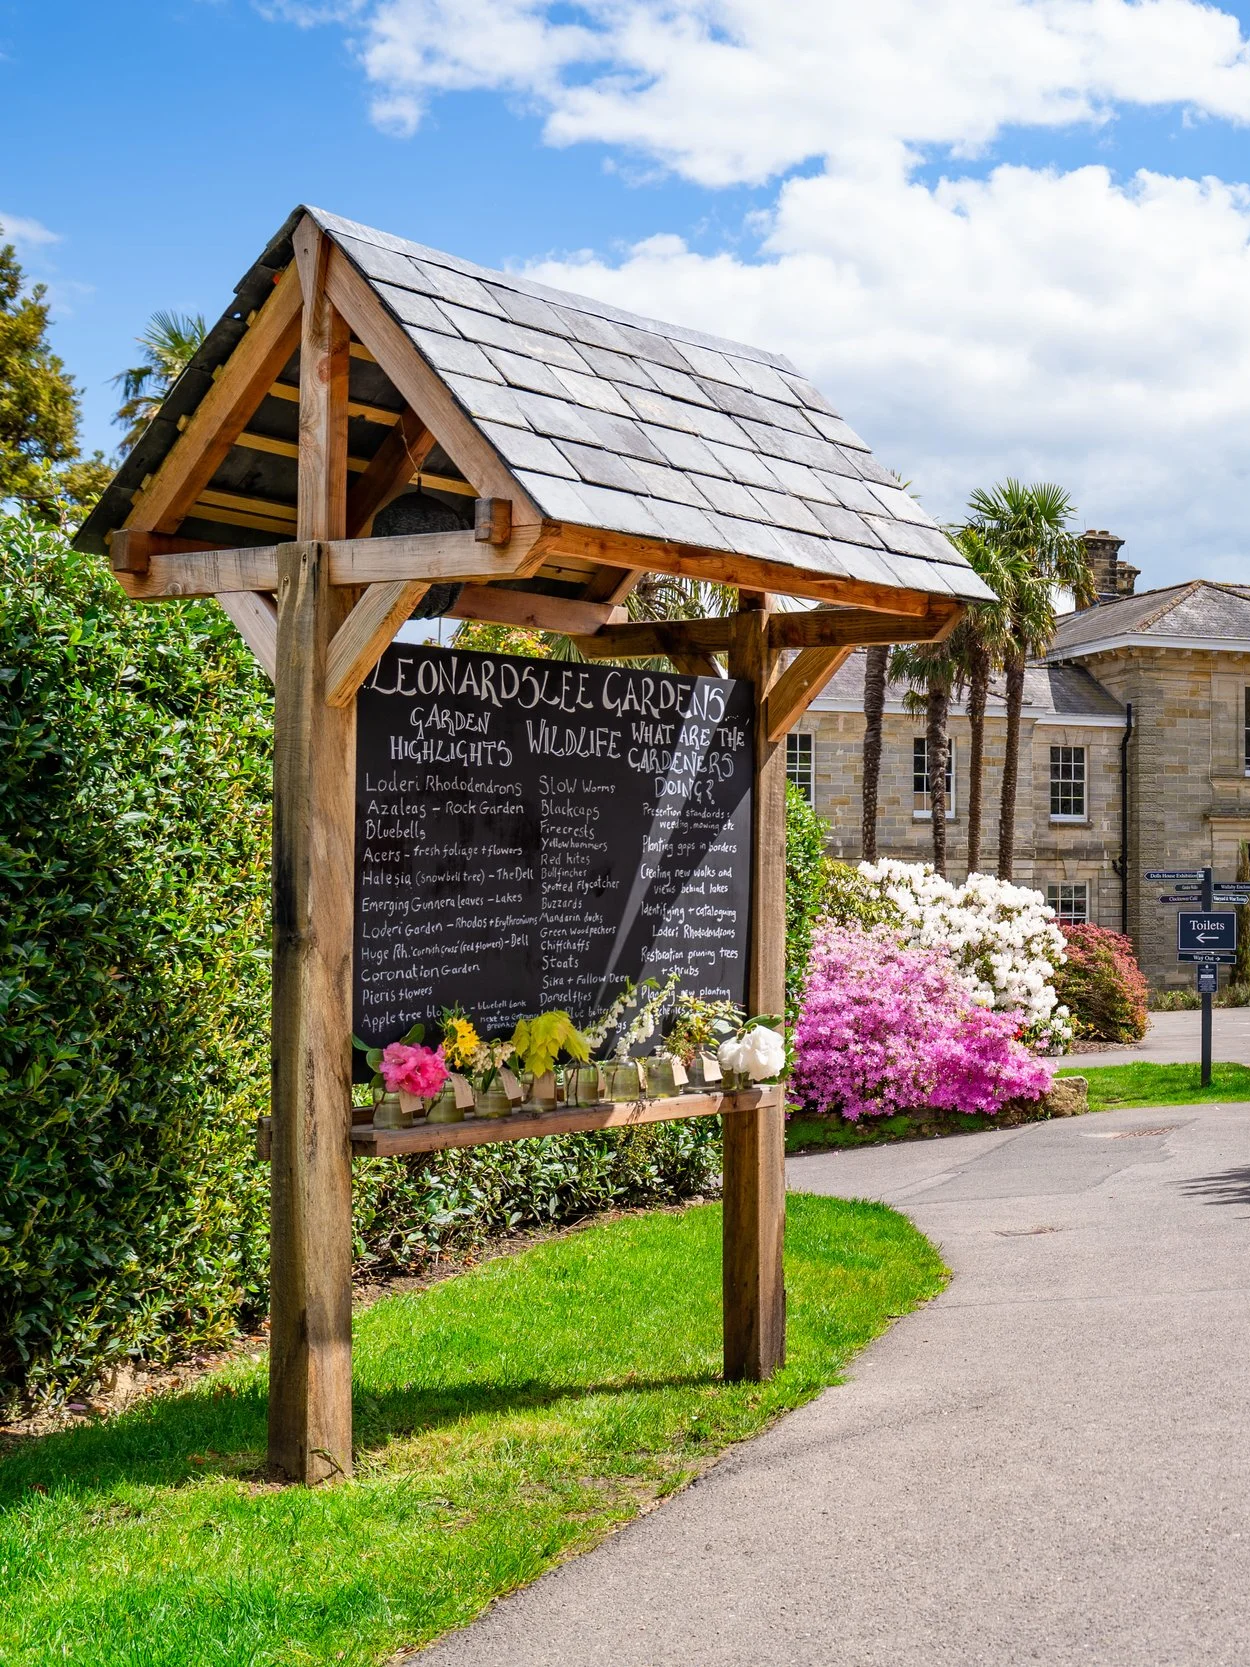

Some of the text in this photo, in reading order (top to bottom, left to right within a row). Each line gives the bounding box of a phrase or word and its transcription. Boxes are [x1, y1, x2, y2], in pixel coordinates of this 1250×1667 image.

[371, 655, 725, 723] LEONARDSLEE GARDENS
[410, 703, 491, 740] GARDEN
[526, 718, 622, 759] WILDLIFE
[631, 720, 745, 751] WHAT ARE THE
[390, 735, 513, 767] HIGHLIGHTS
[628, 747, 735, 782] GARDENERS
[366, 769, 523, 797] Loderi Rhododendrons
[655, 776, 715, 805] DOING?
[367, 797, 427, 818] Azaleas
[445, 800, 476, 815] Rock
[479, 801, 524, 814] Garden
[541, 798, 600, 825] Blackcaps
[366, 818, 426, 840] Bluebells
[540, 818, 595, 840] Firecrests
[693, 821, 720, 836] mowing
[722, 819, 735, 831] etc
[363, 847, 401, 863] Acers
[413, 844, 441, 857] fresh
[442, 841, 478, 863] foliage
[487, 844, 523, 857] flowers
[541, 837, 608, 852] Yellowhammers
[642, 834, 738, 858] Planting gaps in borders
[540, 852, 562, 866] Red
[362, 868, 412, 886] Halesia
[541, 866, 587, 882] Bullfinches
[640, 863, 733, 888] Creating new walks and
[541, 874, 620, 896] Spotted Flycatcher
[653, 882, 729, 895] views behind lakes
[361, 897, 409, 917] Emerging
[411, 896, 456, 912] Gunnera
[495, 892, 523, 903] Lakes
[541, 897, 583, 910] Buzzards
[641, 901, 685, 924] Identifying
[362, 920, 402, 939] Loderi
[405, 922, 443, 937] Garden
[455, 915, 487, 929] Rhodos
[539, 912, 581, 923] Mandarin
[1189, 920, 1225, 931] Toilets
[540, 925, 617, 938] Green Woodpeckers
[652, 924, 736, 939] Loderi Rhododendrons
[361, 947, 389, 965] Huge
[510, 934, 529, 948] Dell
[540, 938, 590, 953] Chiffchaffs
[640, 945, 739, 965] Restoration pruning trees
[361, 963, 481, 982] Coronation Garden
[542, 954, 579, 971] Stoats
[542, 974, 564, 990] Sika
[609, 972, 628, 983] Deer
[362, 985, 433, 1006] Pieris flowers
[540, 989, 592, 1007] Damselflies
[699, 986, 731, 1002] planting
[361, 1012, 396, 1033] Apple
[398, 1007, 422, 1022] tree
[477, 1000, 507, 1010] bluebell
